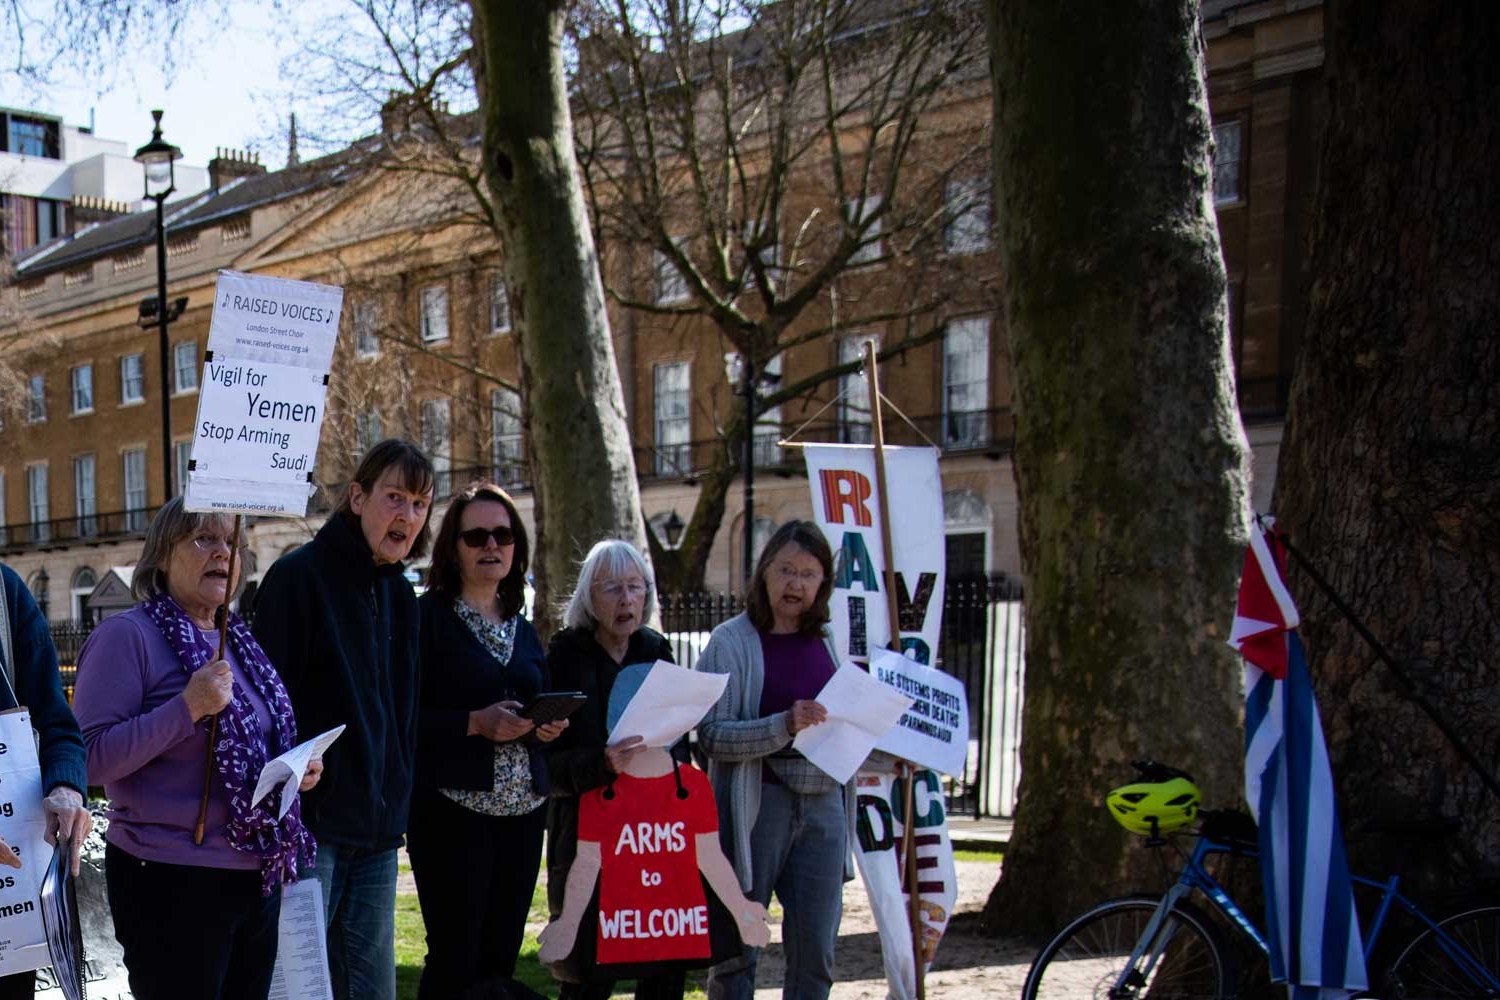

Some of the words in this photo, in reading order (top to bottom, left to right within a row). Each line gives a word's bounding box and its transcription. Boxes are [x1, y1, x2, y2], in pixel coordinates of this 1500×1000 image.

[234, 296, 277, 315] RAISED
[282, 303, 323, 322] VOICES
[247, 323, 269, 333] London
[270, 326, 288, 336] Street
[288, 328, 304, 338] Choir
[236, 337, 309, 353] www.raised-voices.org.uk
[210, 364, 242, 388] Vigil
[246, 368, 268, 387] for
[247, 392, 316, 423] Yemen
[201, 421, 234, 443] Stop
[237, 425, 290, 449] Arming
[270, 452, 307, 471] Saudi
[211, 501, 285, 513] www.raised-voices.org.uk
[896, 673, 930, 699] SYSTEMS
[931, 687, 960, 711] PROFITS
[931, 704, 959, 728] DEATHS
[615, 821, 686, 855] ARMS
[641, 869, 662, 886] to
[599, 906, 709, 939] WELCOME
